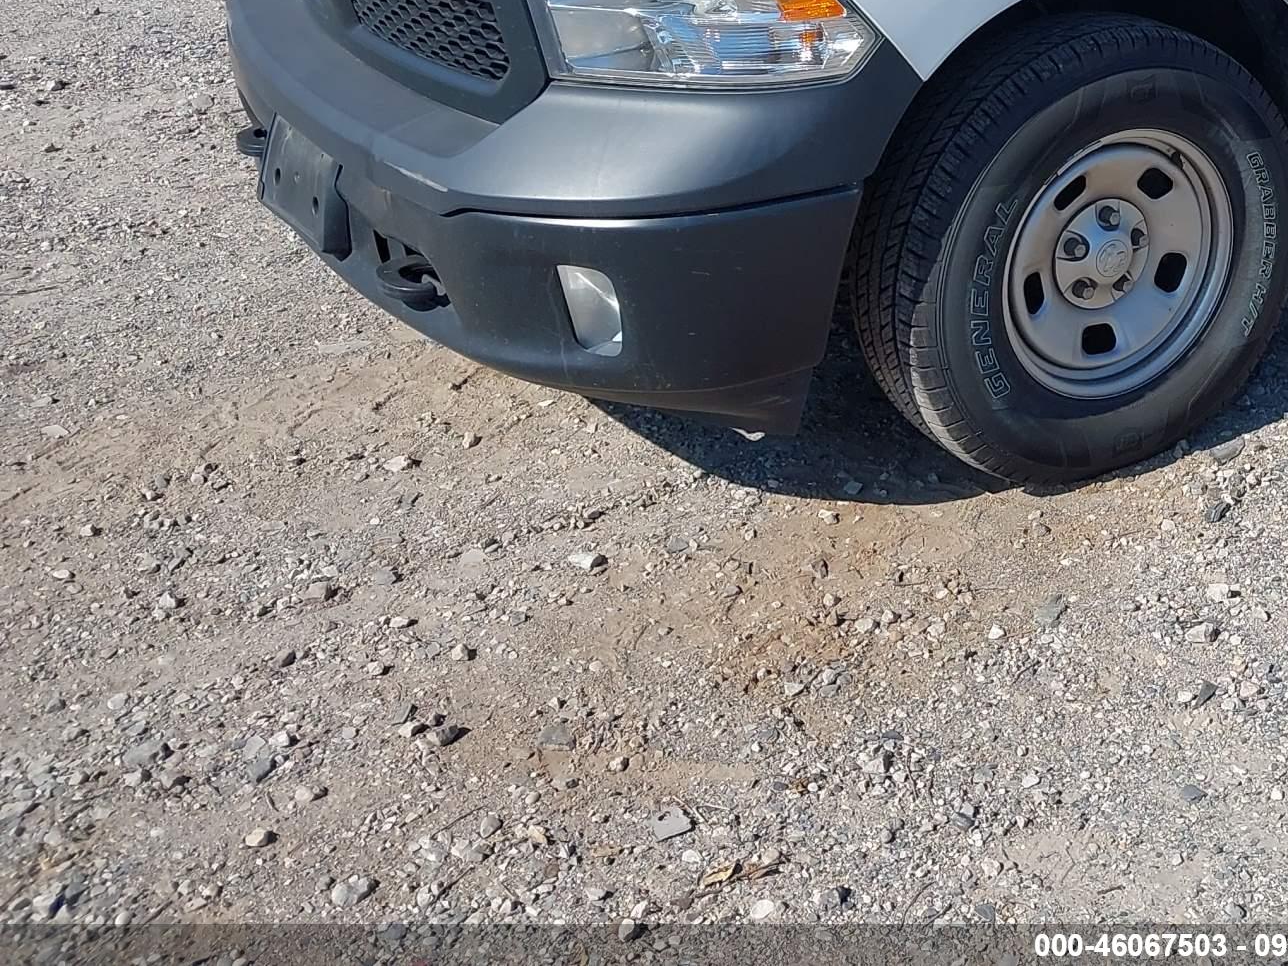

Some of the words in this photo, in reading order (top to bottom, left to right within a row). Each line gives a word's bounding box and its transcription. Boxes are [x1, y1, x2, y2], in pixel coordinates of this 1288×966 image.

[1247, 151, 1277, 279] GRABBER
[970, 199, 1018, 399] GENERAL
[1241, 283, 1267, 338] H/T
